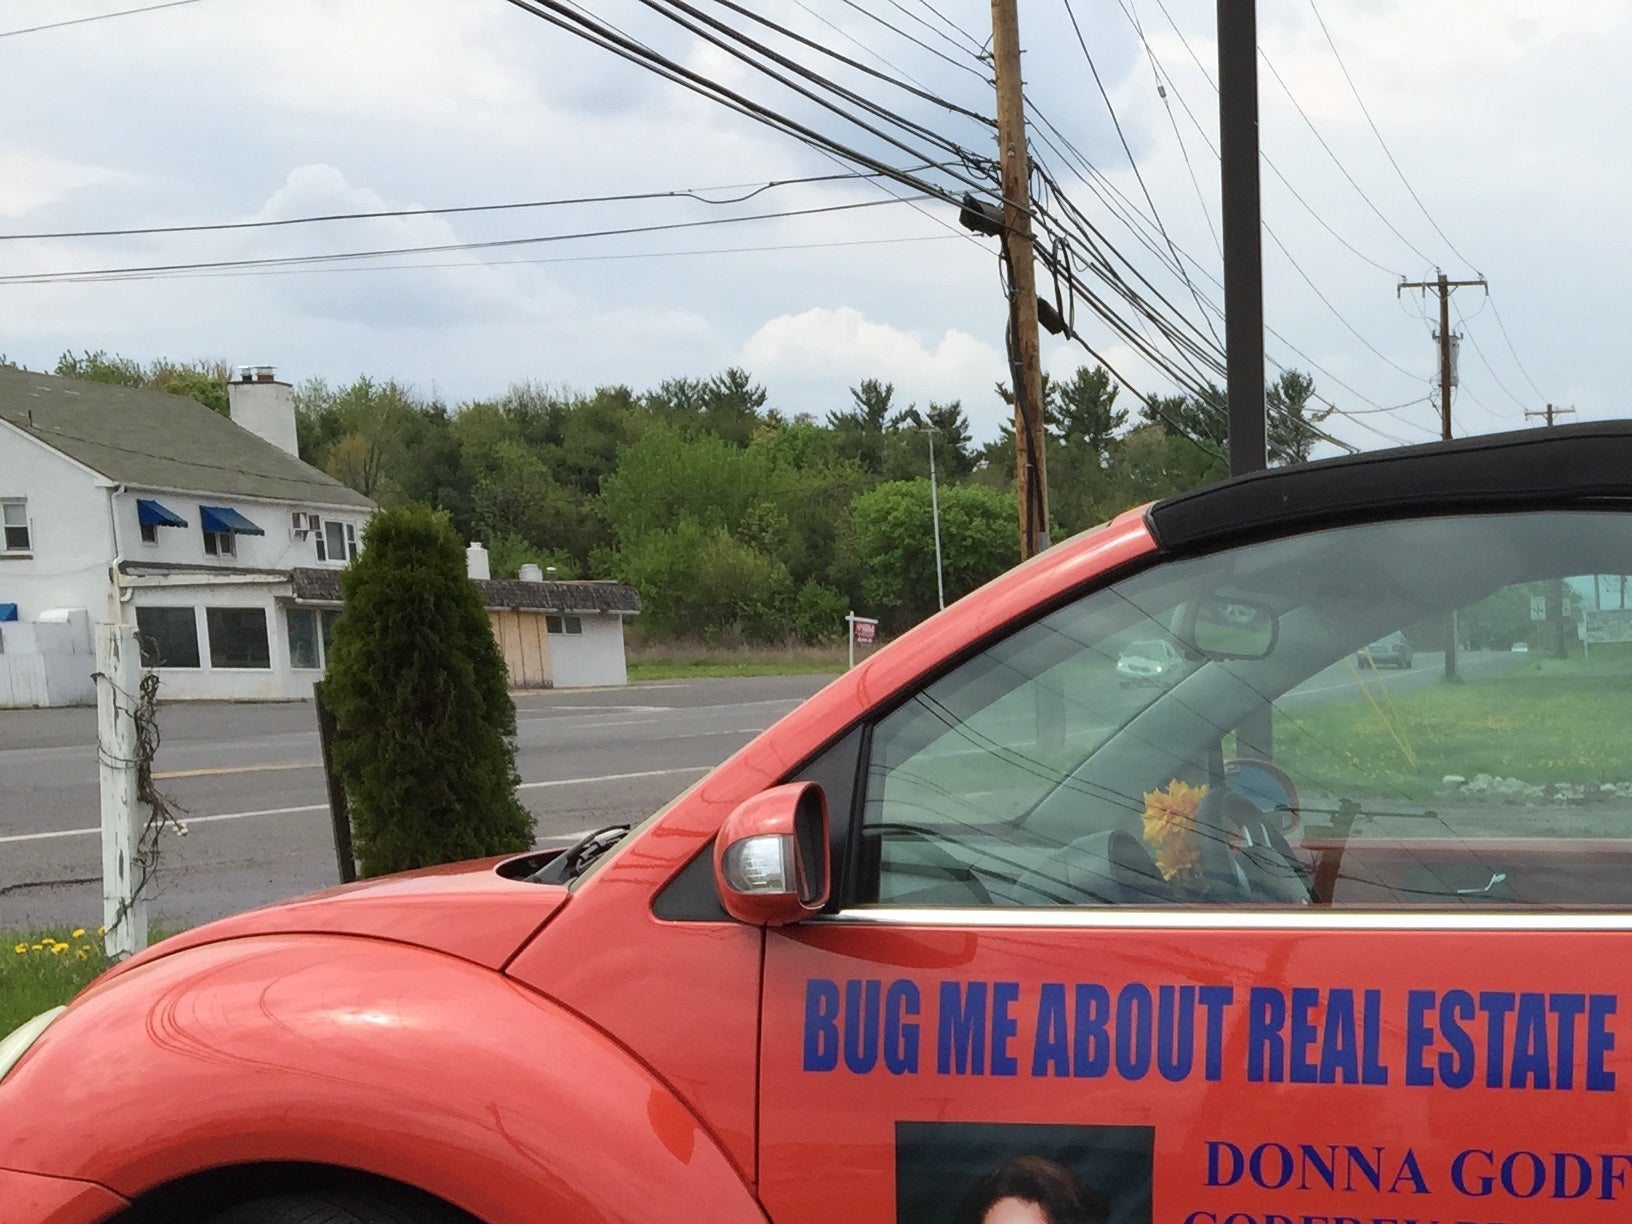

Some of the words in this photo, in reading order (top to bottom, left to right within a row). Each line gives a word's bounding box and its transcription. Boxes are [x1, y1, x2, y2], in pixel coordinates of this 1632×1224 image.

[802, 977, 920, 1076] BUG
[937, 980, 1020, 1077] ME
[1031, 982, 1234, 1083] ABOUT
[1247, 987, 1389, 1086] REAL
[1404, 989, 1618, 1092] ESTATE
[1203, 1140, 1432, 1194] DONNA
